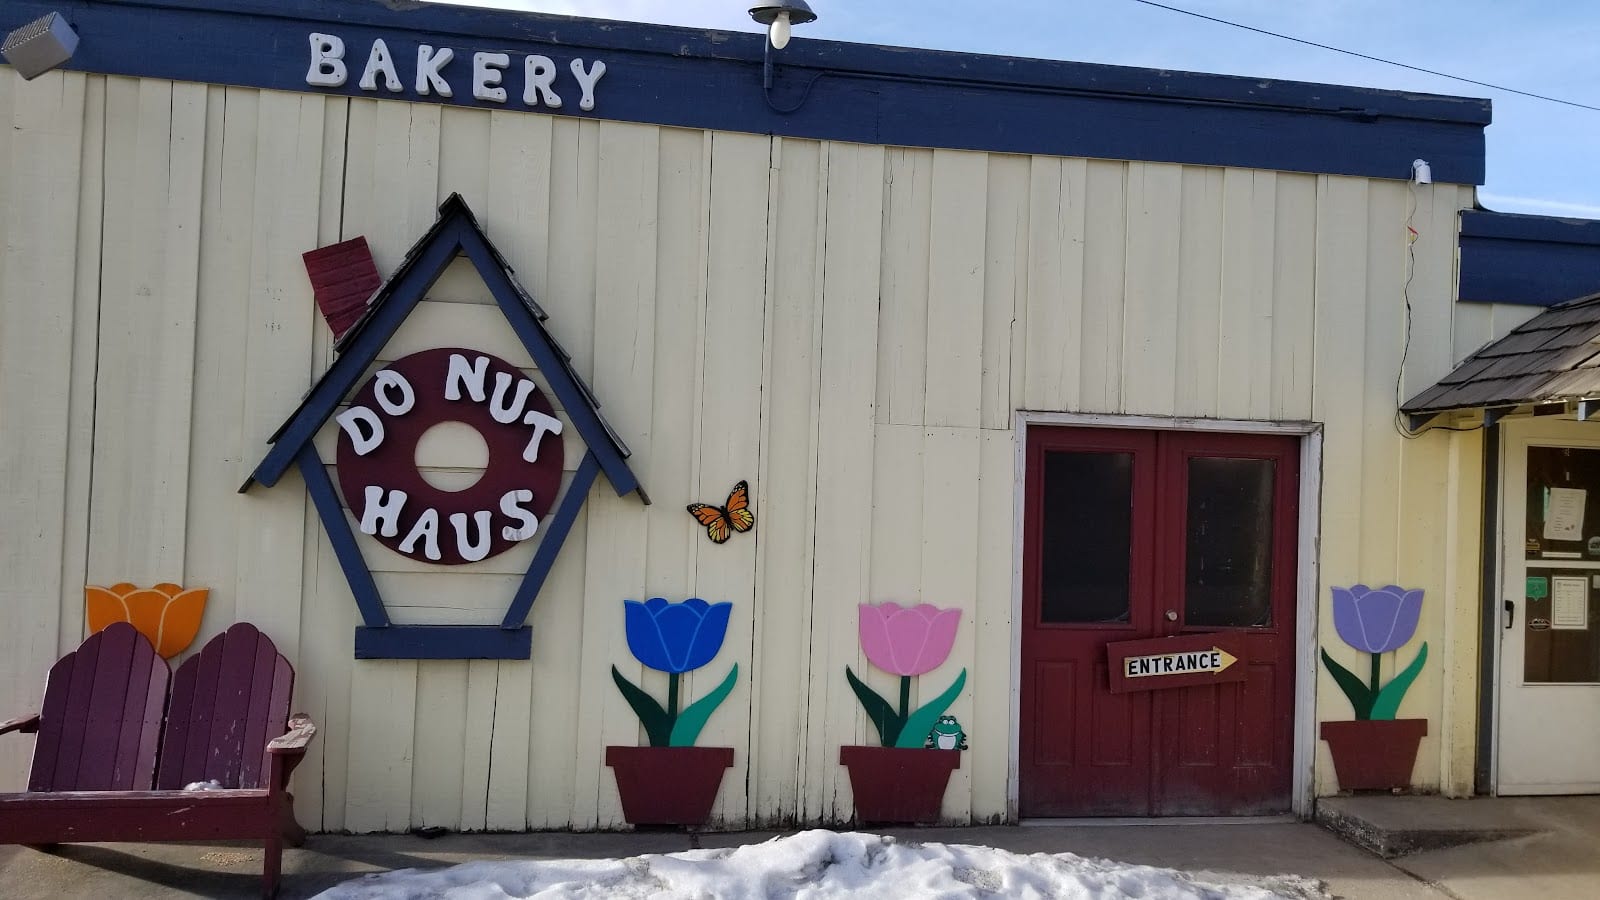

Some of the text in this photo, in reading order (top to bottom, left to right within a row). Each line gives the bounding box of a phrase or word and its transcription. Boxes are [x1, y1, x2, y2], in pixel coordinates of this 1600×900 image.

[306, 32, 607, 111] BAKERY
[360, 485, 539, 562] HAUS
[1128, 652, 1221, 676] ENTRANCE
